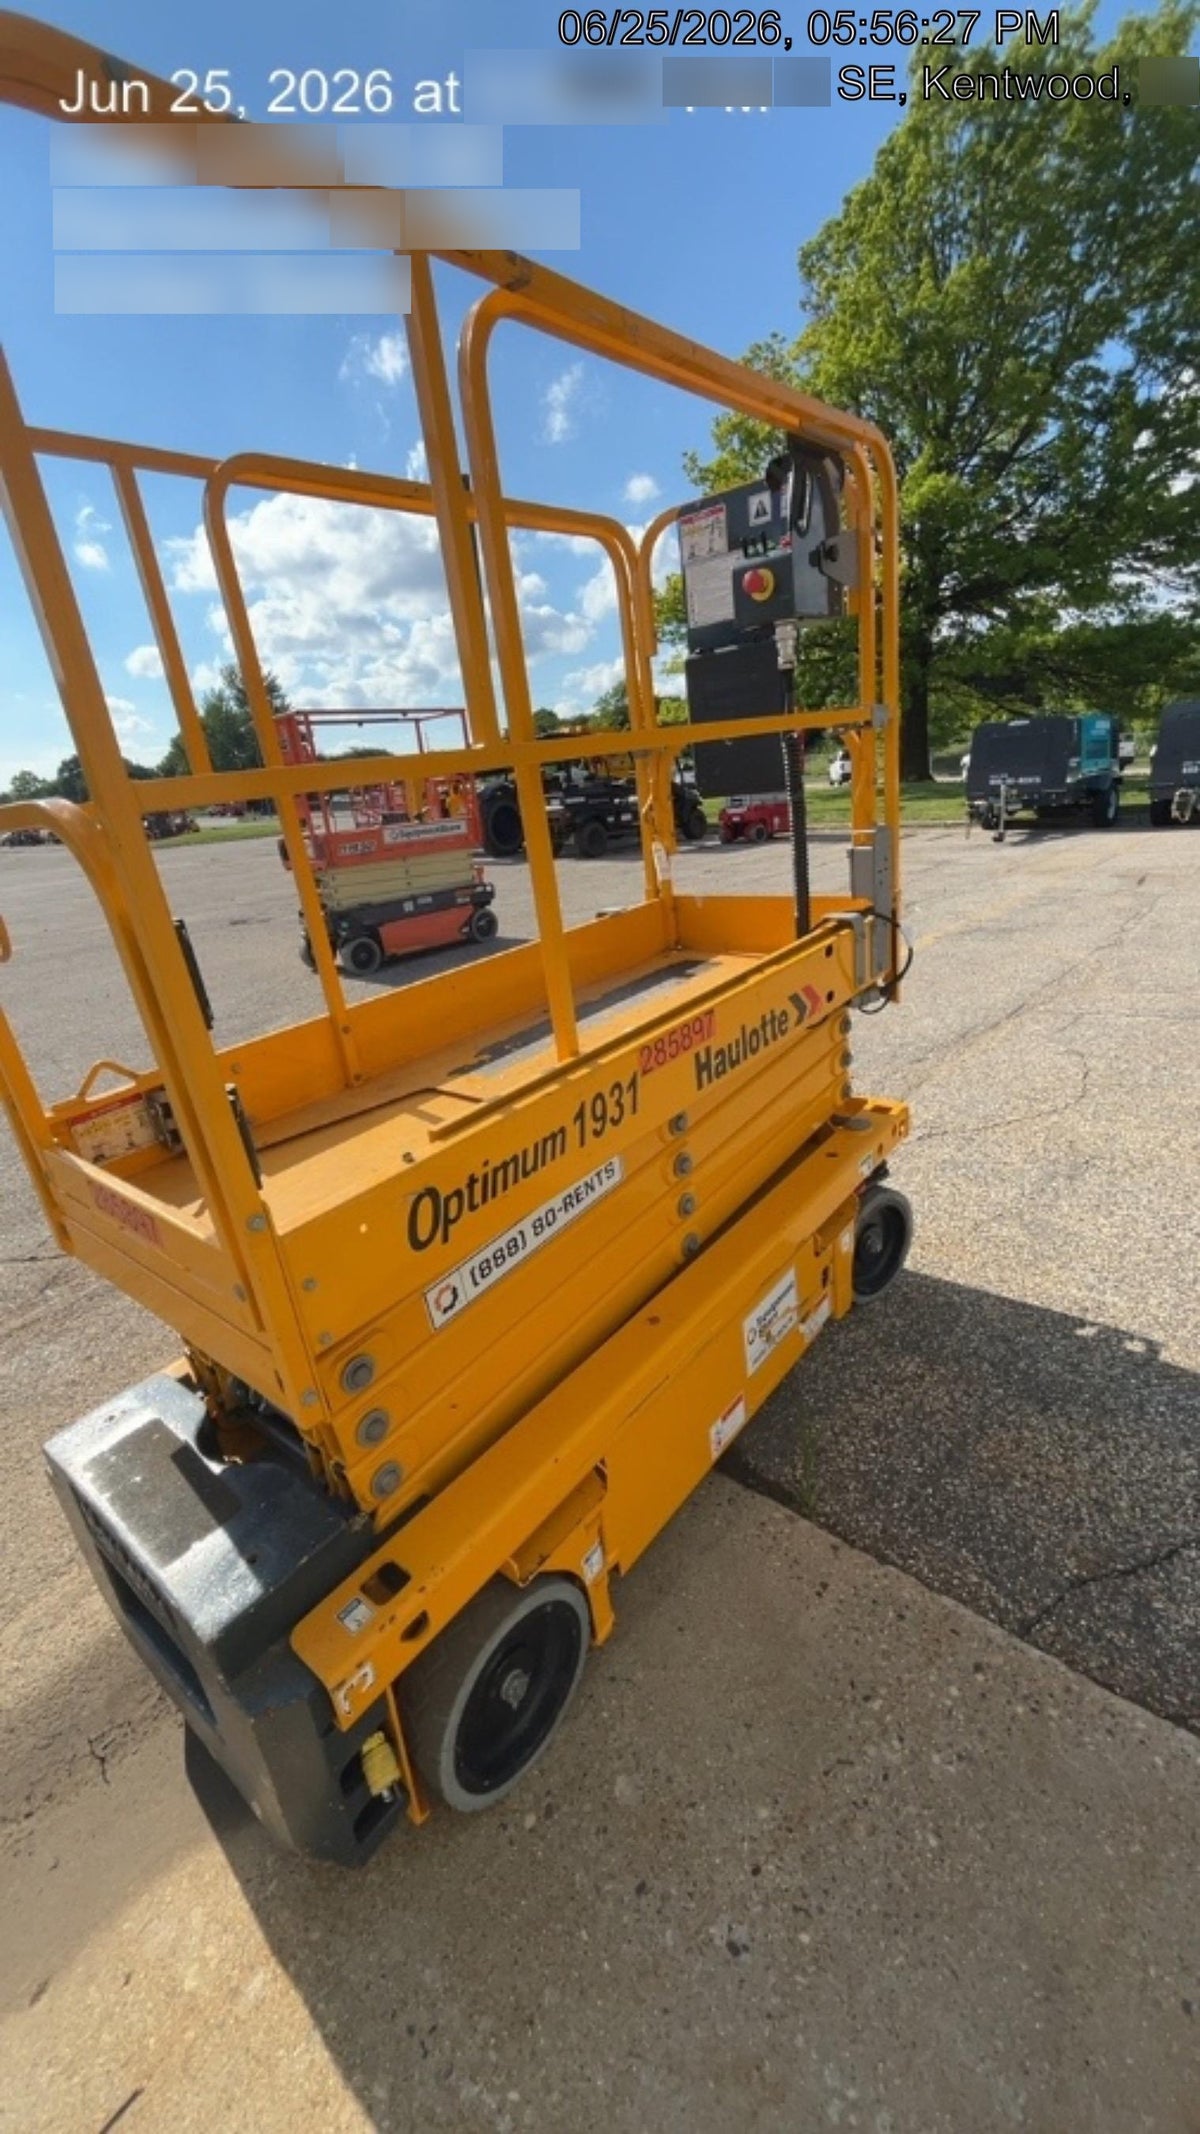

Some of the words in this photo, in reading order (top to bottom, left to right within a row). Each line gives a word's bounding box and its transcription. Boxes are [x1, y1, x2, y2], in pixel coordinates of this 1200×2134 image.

[640, 1008, 717, 1077] 285897
[693, 1008, 790, 1092] Haulotte
[407, 1126, 567, 1253] Optimum
[573, 1070, 640, 1149] 1931
[468, 1229, 528, 1288] (888)
[531, 1160, 617, 1238] 80-RENTS
